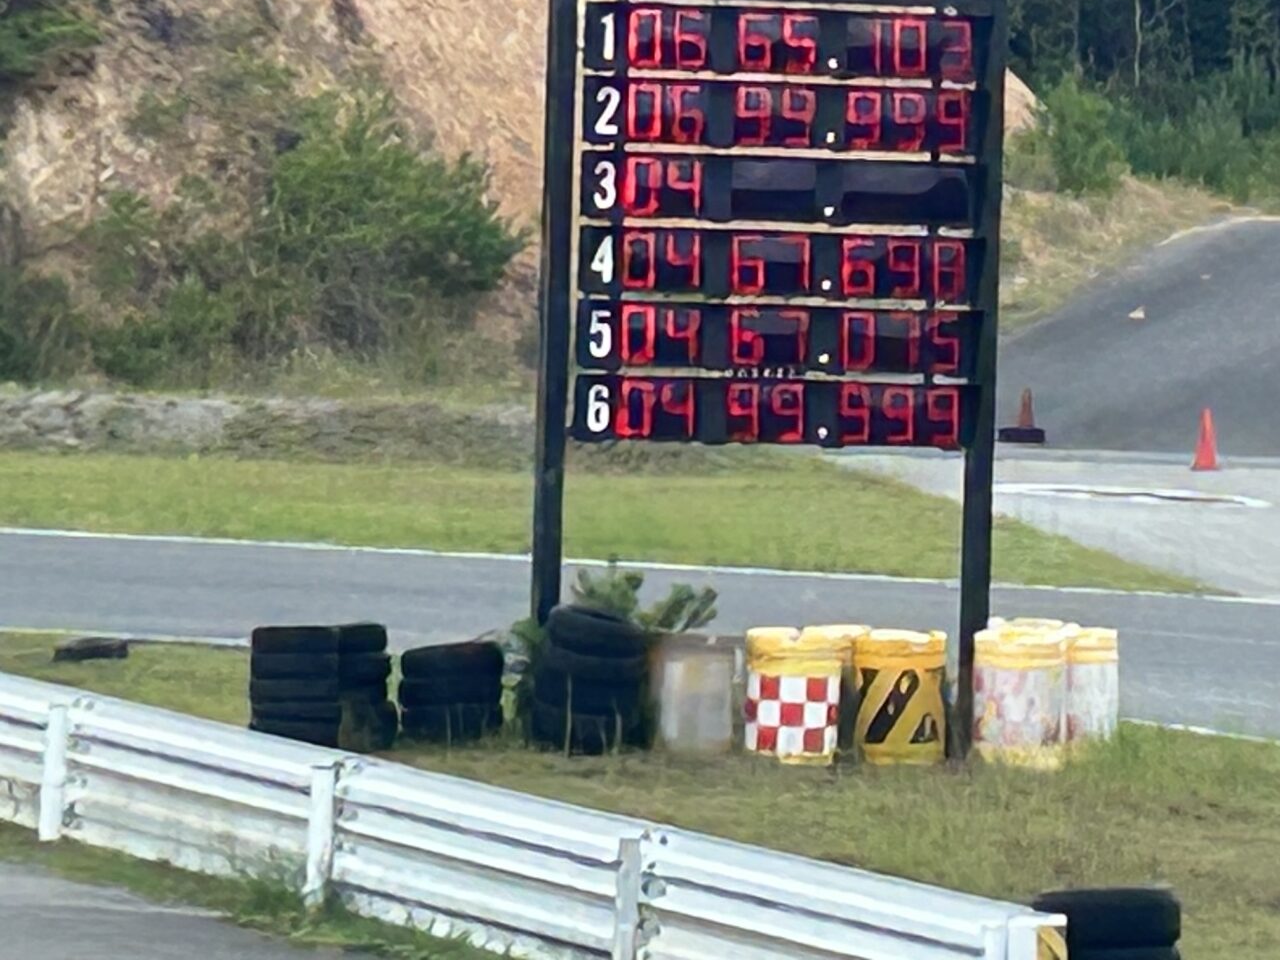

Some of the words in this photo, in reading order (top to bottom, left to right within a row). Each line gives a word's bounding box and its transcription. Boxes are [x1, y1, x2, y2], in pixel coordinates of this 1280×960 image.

[601, 13, 615, 60] 1
[629, 9, 706, 69] 06
[594, 86, 620, 135] 2
[628, 83, 704, 143] 06
[593, 161, 616, 209] 3
[622, 156, 702, 216] 04
[591, 235, 613, 283] 4
[623, 231, 700, 287] 04
[589, 310, 612, 358] 5
[622, 304, 700, 365] 04
[587, 384, 610, 432] 6
[616, 380, 694, 436] 04
